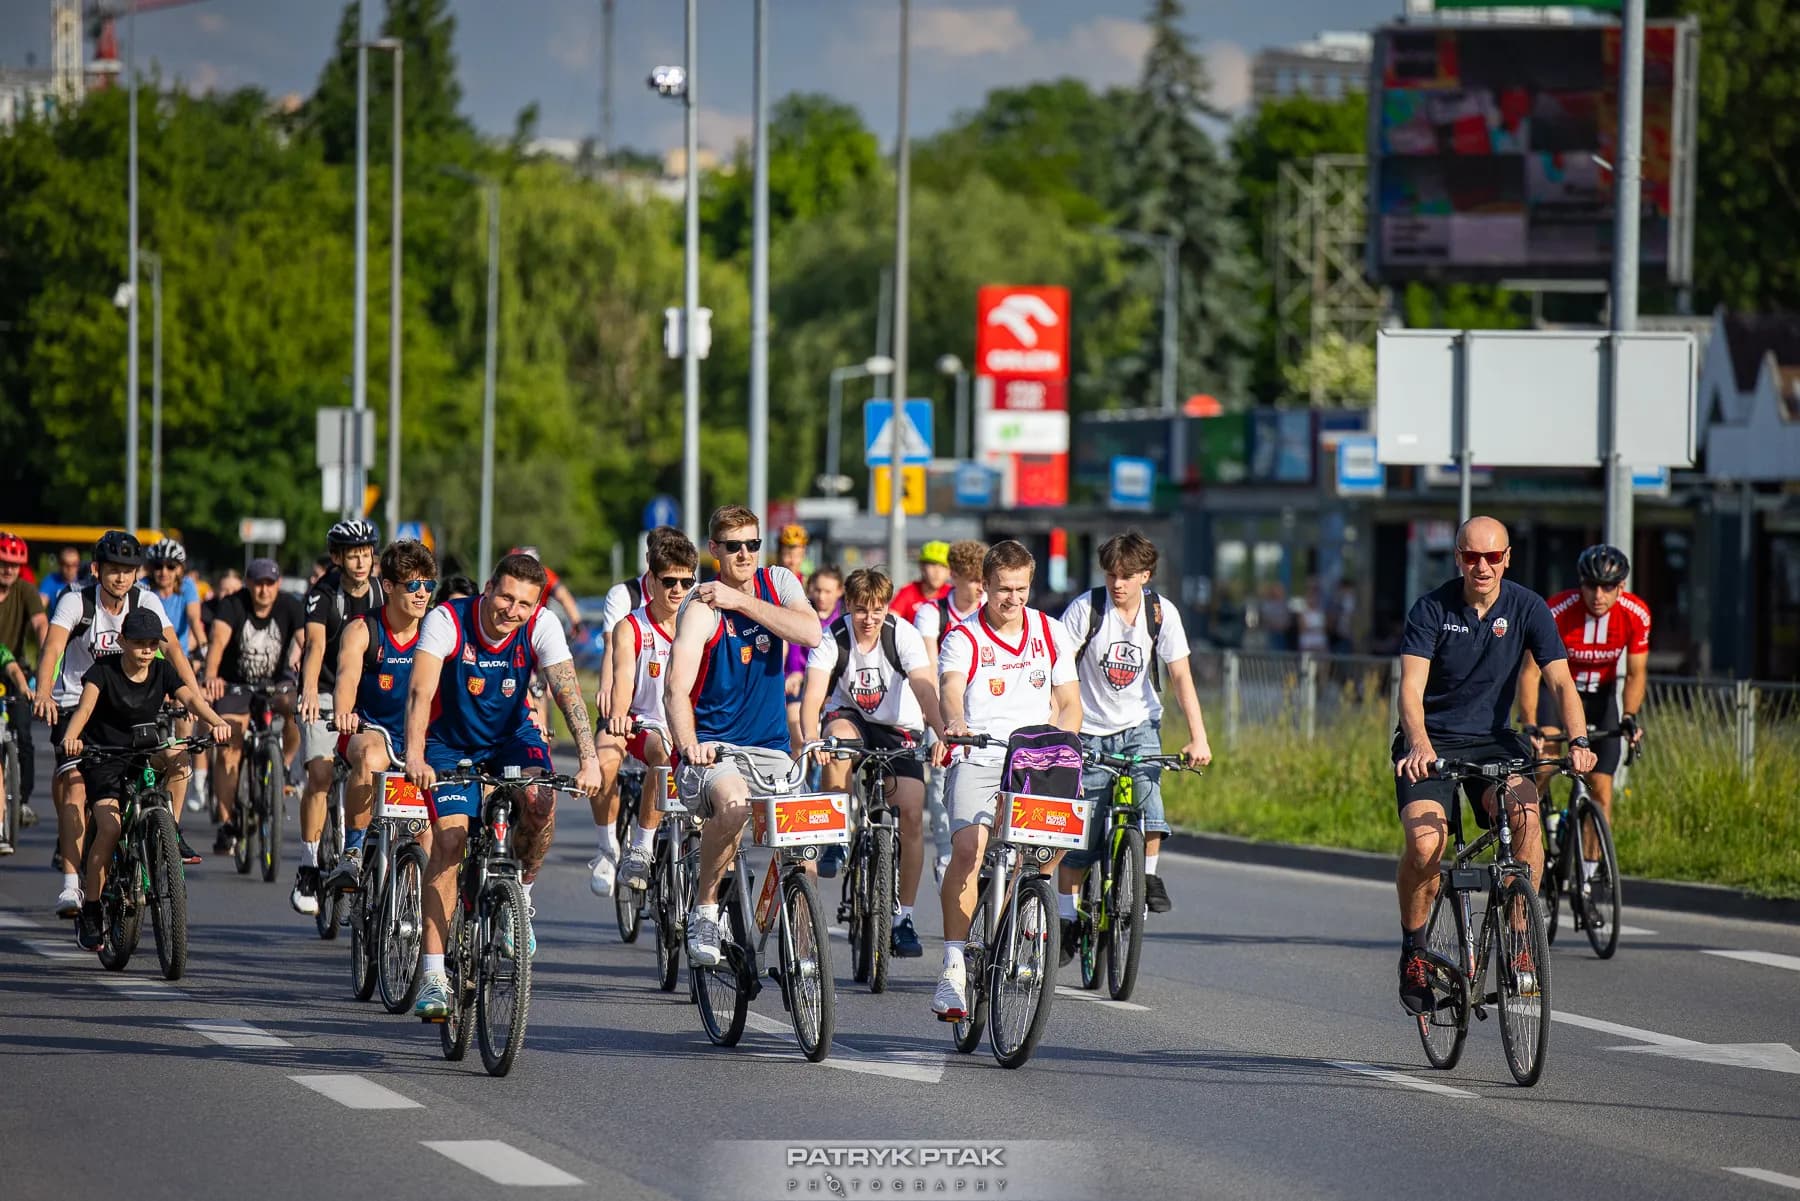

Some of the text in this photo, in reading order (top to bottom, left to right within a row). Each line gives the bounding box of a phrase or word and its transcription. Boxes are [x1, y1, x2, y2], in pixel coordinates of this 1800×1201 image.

[1550, 594, 1580, 618] nweb
[1031, 637, 1045, 659] 14
[479, 660, 509, 669] GIVOVA
[527, 747, 543, 760] 13
[437, 794, 468, 803] GIVOA
